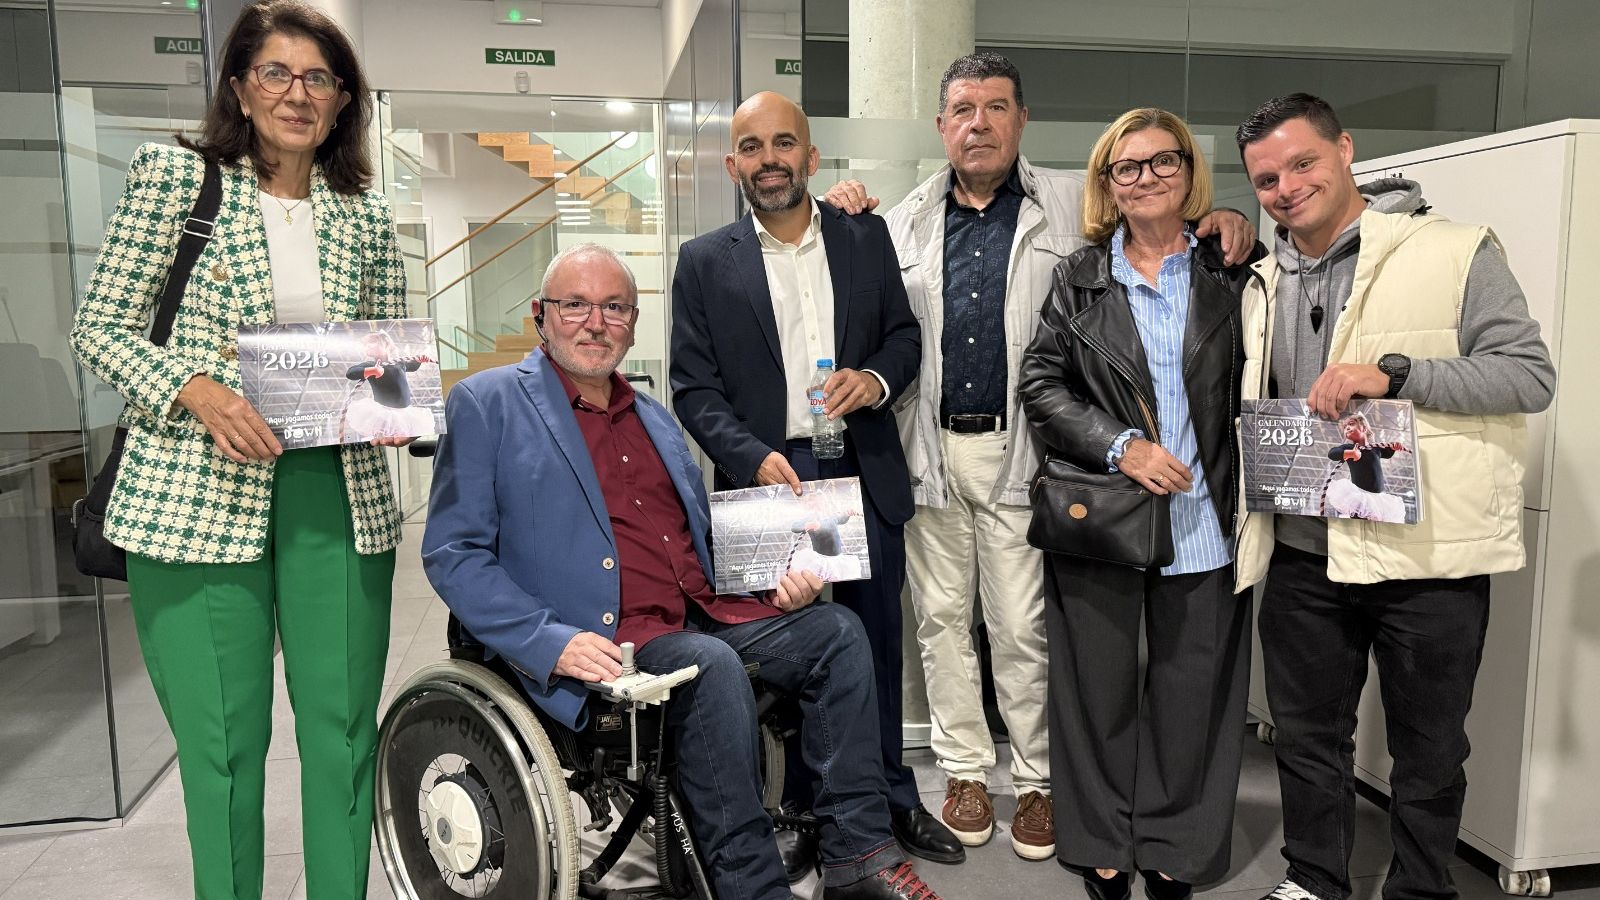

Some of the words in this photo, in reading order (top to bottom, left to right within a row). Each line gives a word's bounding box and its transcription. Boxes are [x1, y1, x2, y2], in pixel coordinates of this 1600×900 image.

[495, 50, 546, 63] SALIDA
[263, 350, 330, 371] 2026
[1258, 419, 1312, 427] CALENDARIO
[1259, 428, 1314, 447] 2026
[459, 715, 526, 815] QUICKIE
